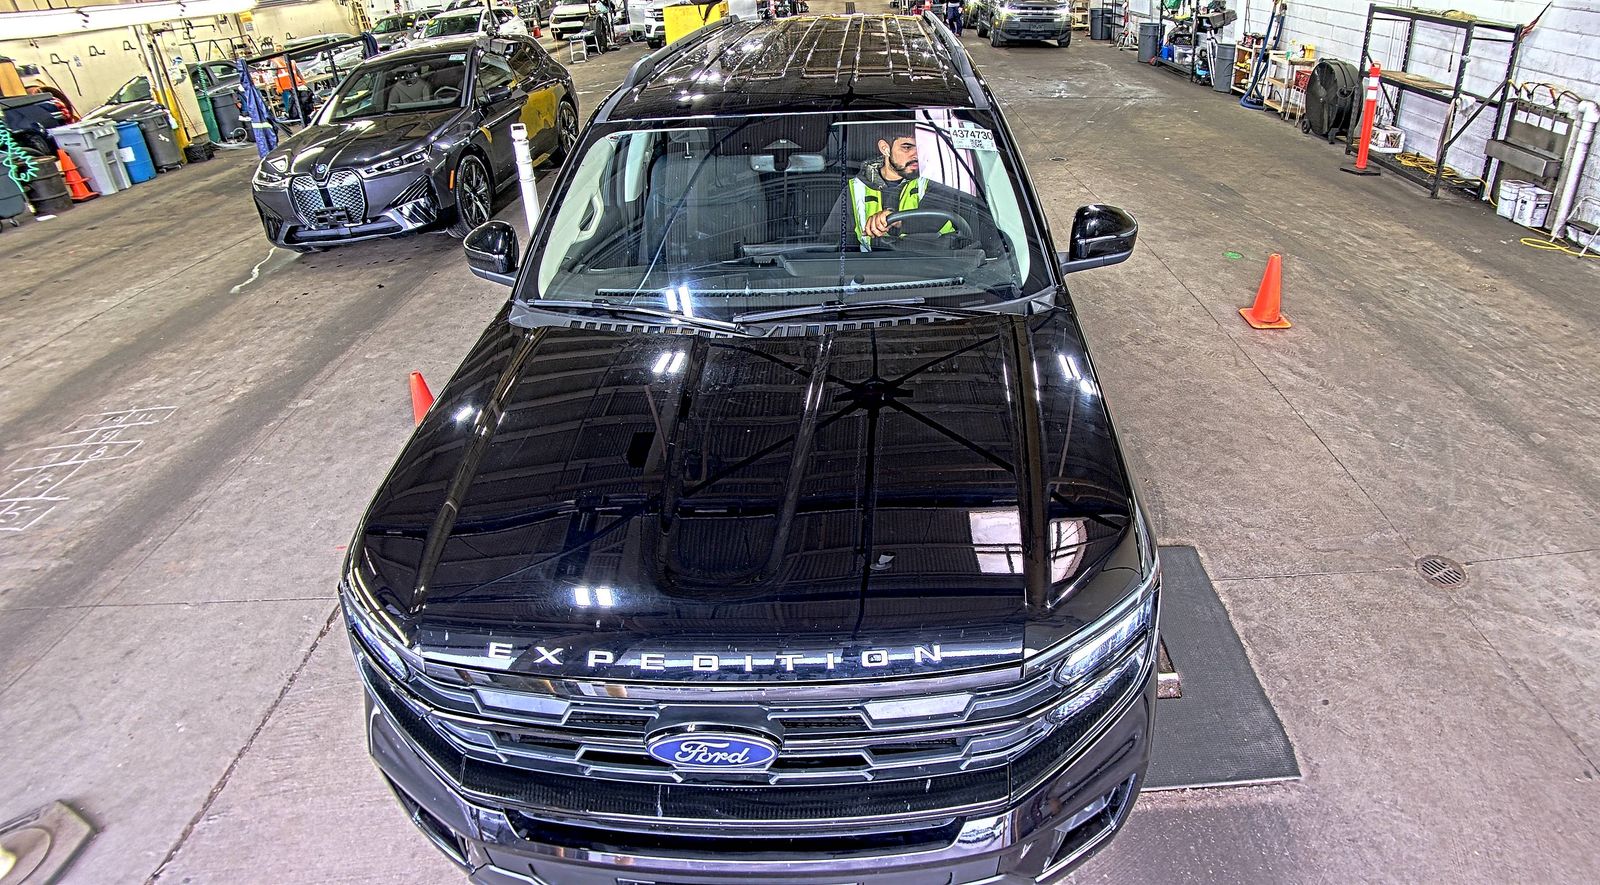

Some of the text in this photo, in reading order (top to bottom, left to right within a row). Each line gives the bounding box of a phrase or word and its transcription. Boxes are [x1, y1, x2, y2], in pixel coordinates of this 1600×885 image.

[952, 130, 994, 140] 4374730
[88, 446, 108, 459] 8
[488, 642, 943, 672] EXPEDITION
[674, 741, 750, 764] Ford
